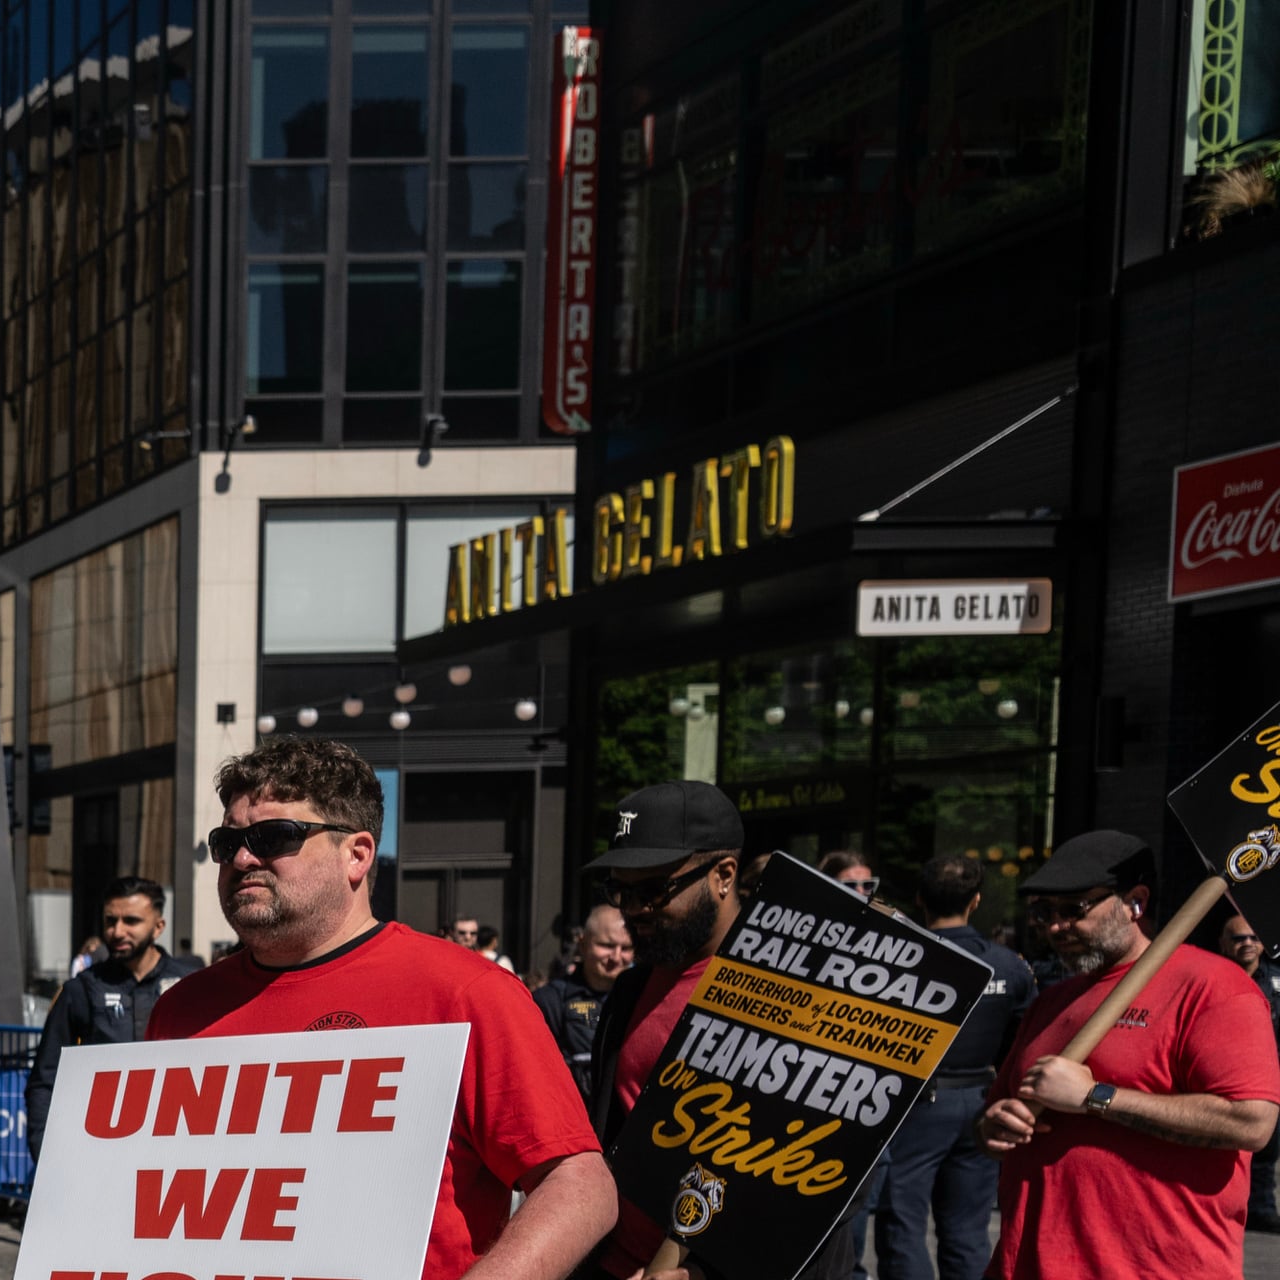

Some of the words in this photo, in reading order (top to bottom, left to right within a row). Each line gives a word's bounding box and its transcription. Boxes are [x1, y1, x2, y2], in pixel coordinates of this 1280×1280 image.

[446, 508, 574, 627] ANITA
[592, 435, 796, 586] GELATO
[872, 593, 942, 624] ANITA
[953, 592, 1040, 622] GELATO
[727, 927, 813, 978] RAIL
[815, 953, 959, 1015] ROAD
[746, 900, 817, 941] LONG
[811, 919, 925, 970] ISLAND
[334, 1013, 362, 1030] STRO
[703, 985, 793, 1026] ENGINEERS
[789, 1017, 815, 1034] and
[815, 1020, 926, 1066] TRAINMEN
[714, 966, 813, 1009] BROTHERHOOD
[811, 1001, 827, 1017] of
[825, 1000, 939, 1046] LOCOMOTIVE
[83, 1055, 406, 1140] UNITE
[658, 1058, 698, 1091] On
[674, 1011, 903, 1128] TEAMSTERS
[651, 1081, 848, 1196] Strike
[132, 1167, 307, 1242] WE
